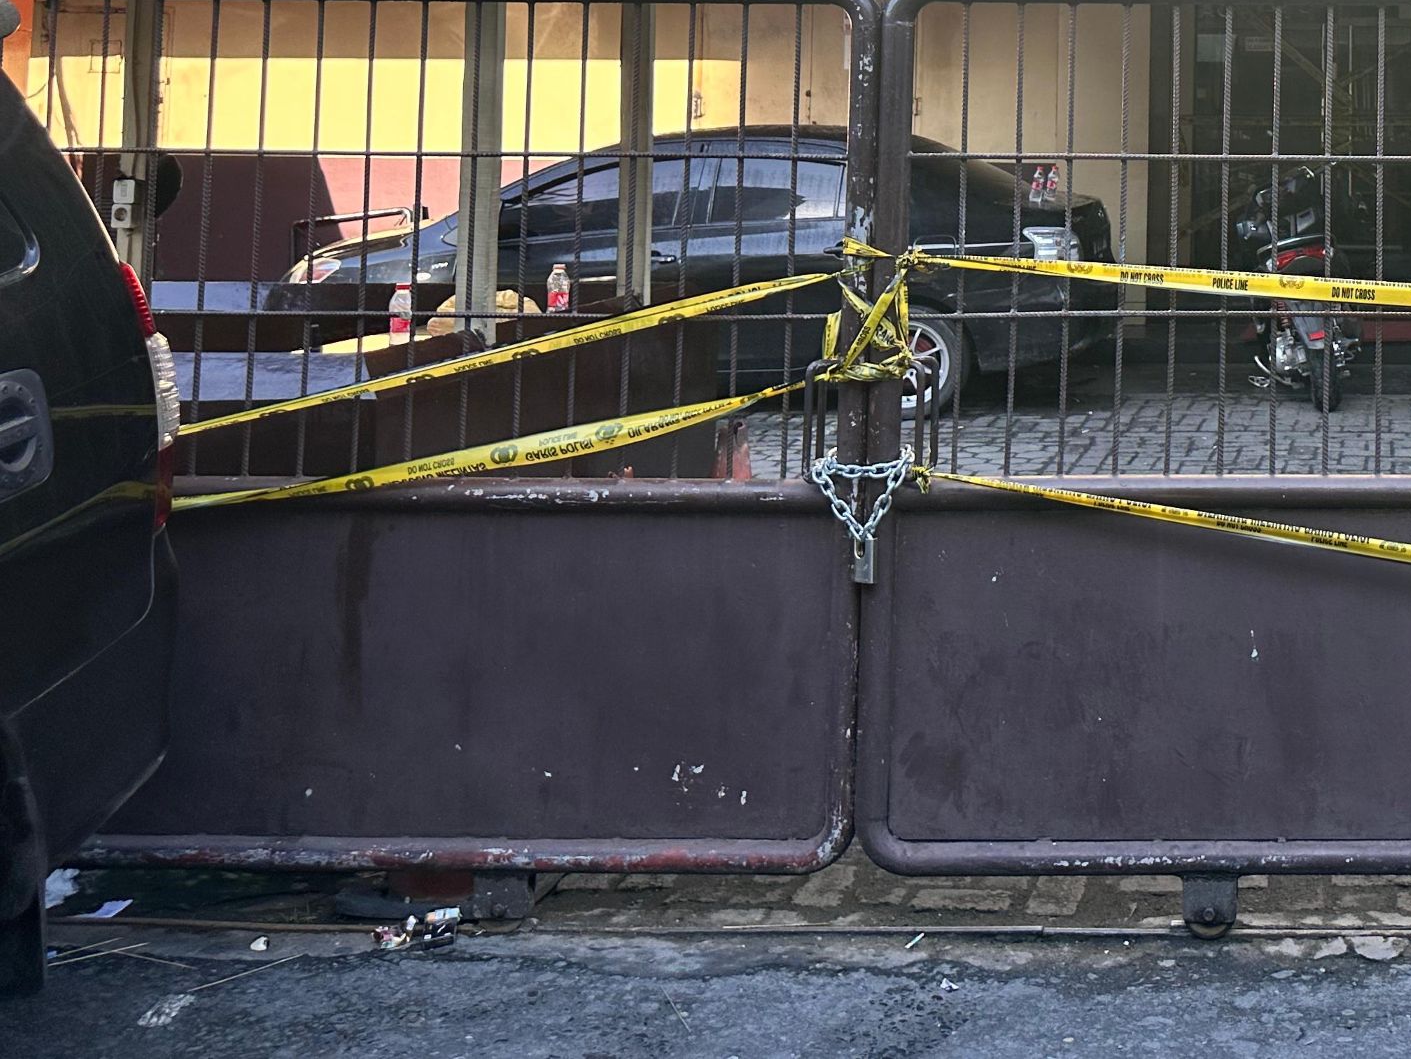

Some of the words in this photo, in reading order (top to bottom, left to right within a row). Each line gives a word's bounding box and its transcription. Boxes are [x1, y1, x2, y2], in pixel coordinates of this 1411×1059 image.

[1120, 270, 1128, 281] DO
[1130, 271, 1142, 282] NOT
[1143, 272, 1163, 284] CROSS
[1212, 277, 1232, 289] POLICE
[1234, 278, 1247, 291] LINE
[1331, 286, 1340, 298] DO
[1341, 287, 1353, 299] NOT
[1355, 288, 1375, 300] CROSS
